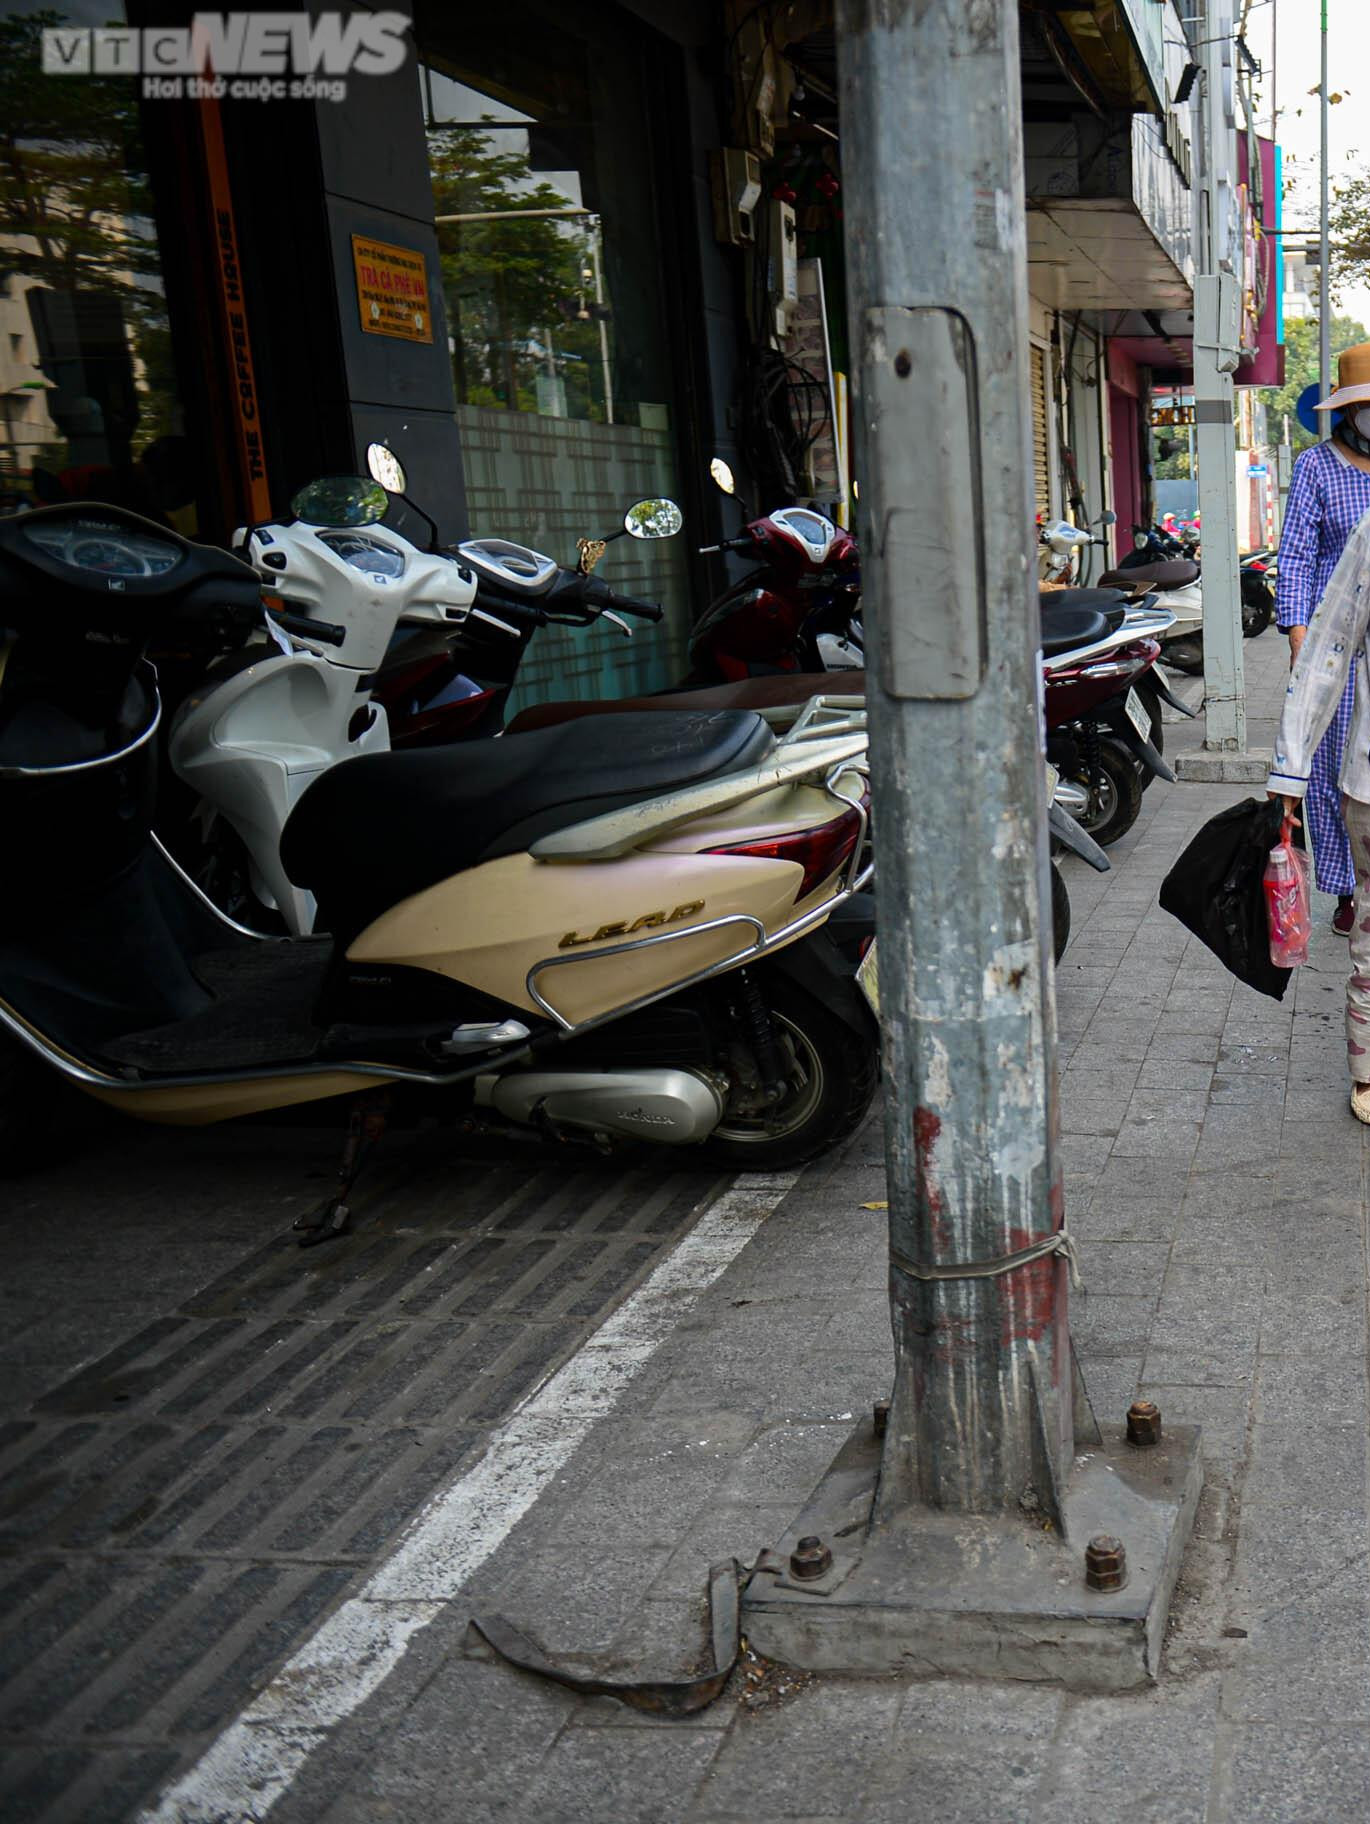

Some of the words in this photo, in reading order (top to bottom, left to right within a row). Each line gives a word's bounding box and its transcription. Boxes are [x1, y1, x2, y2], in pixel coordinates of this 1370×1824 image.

[215, 207, 241, 302] HOUSE
[230, 311, 257, 421] COFFEE
[245, 431, 266, 482] THE
